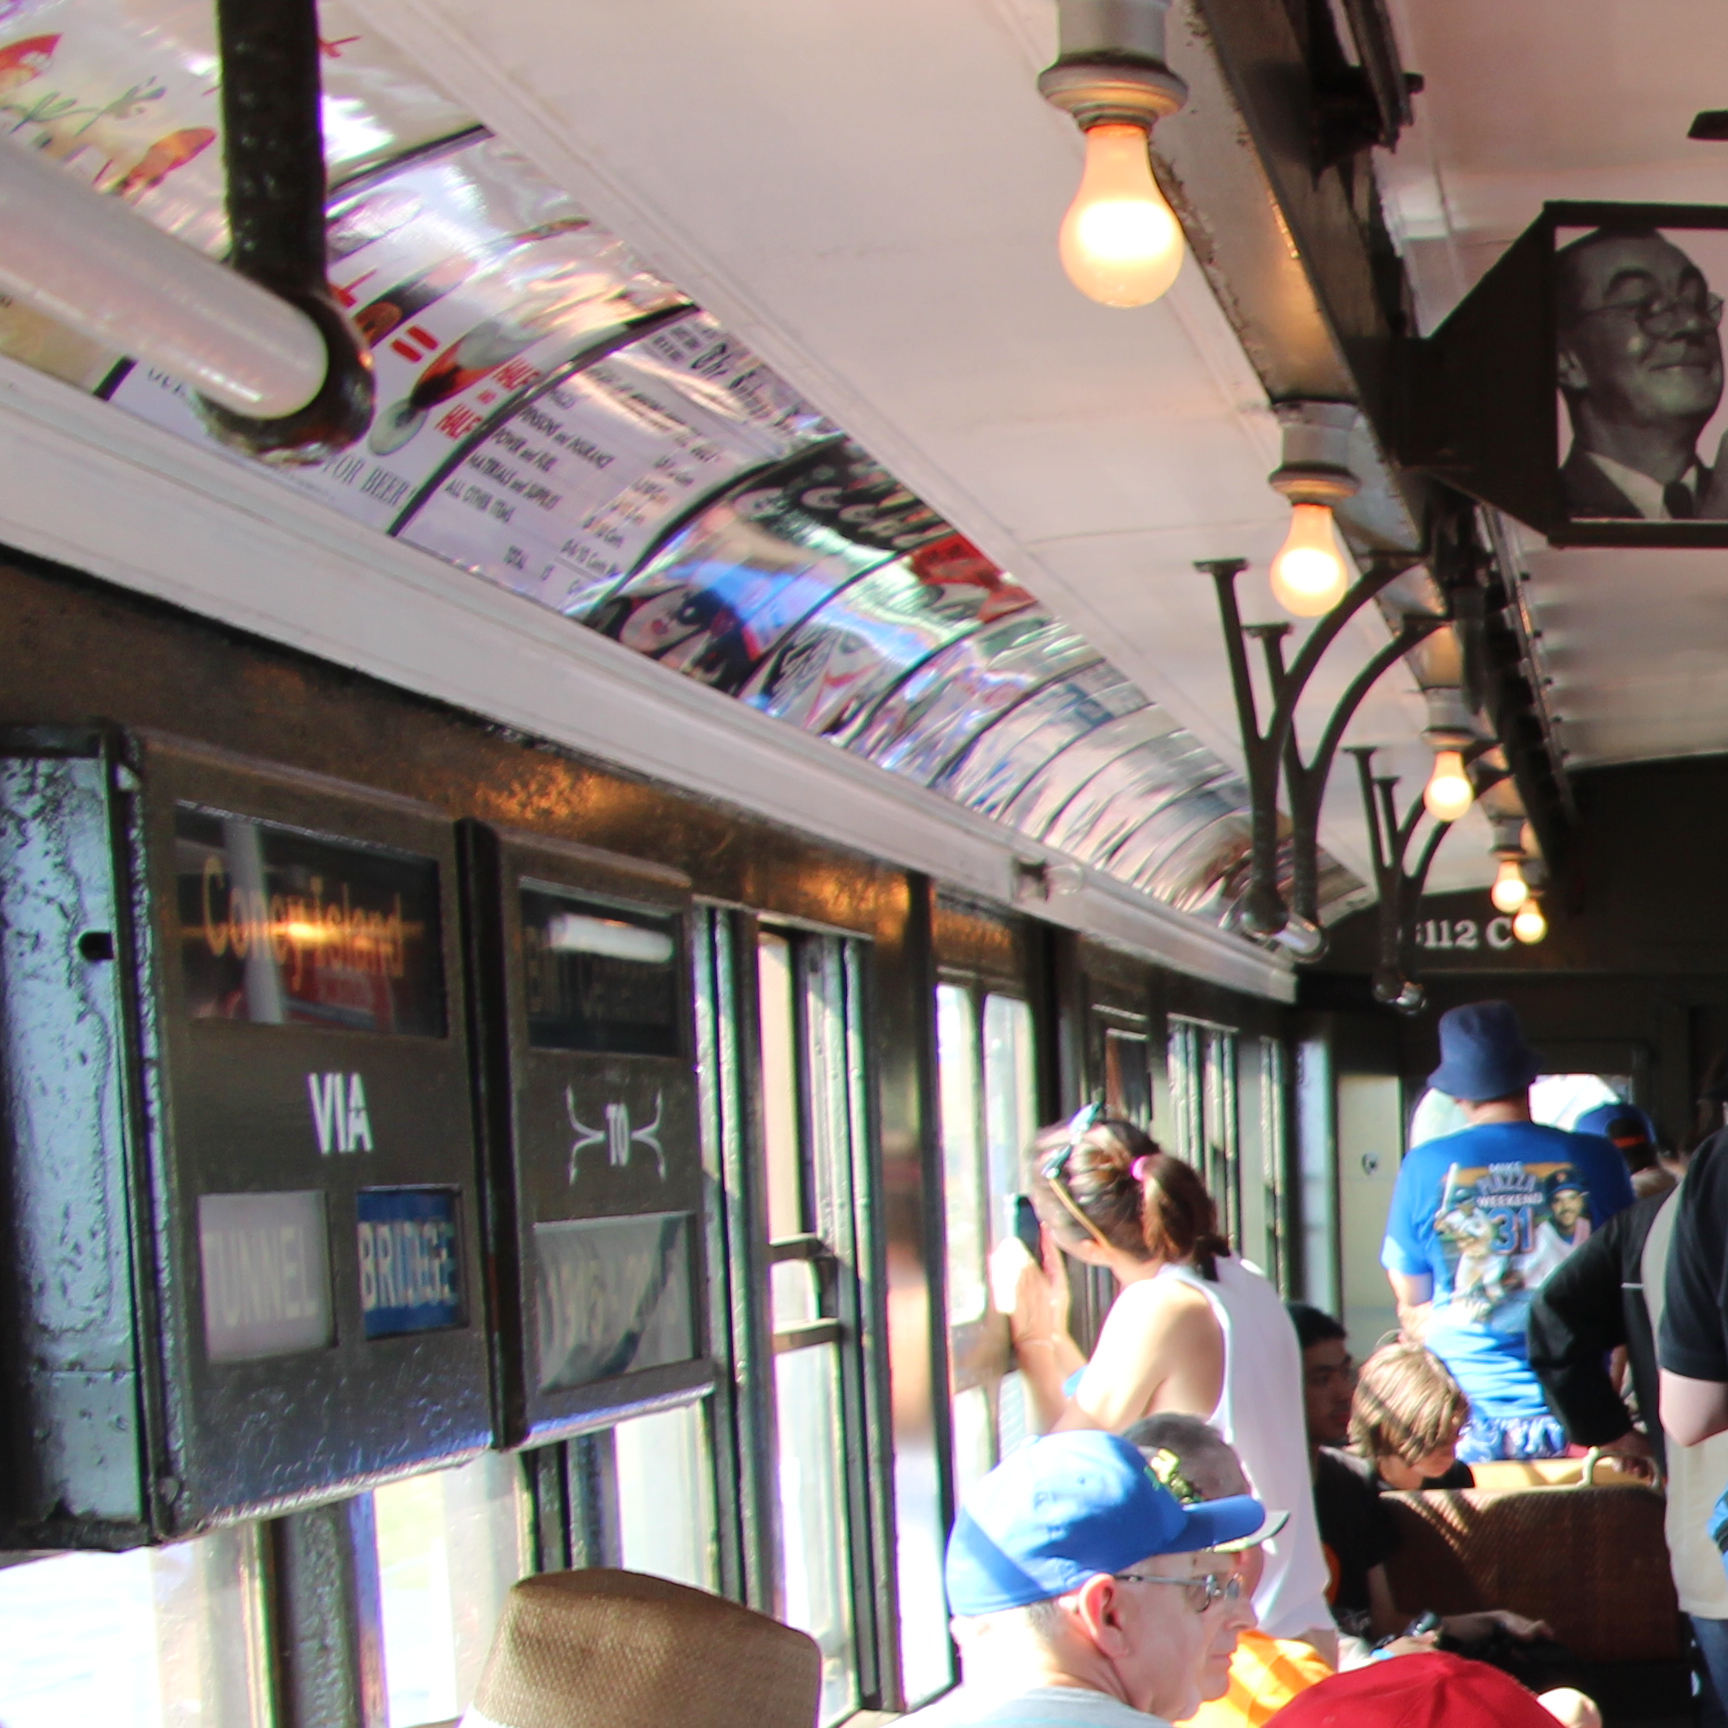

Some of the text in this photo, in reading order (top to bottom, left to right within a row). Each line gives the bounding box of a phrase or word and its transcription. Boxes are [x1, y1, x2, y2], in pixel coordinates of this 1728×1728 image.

[443, 478, 464, 499] ALL
[1485, 916, 1514, 949] C
[307, 1073, 373, 1154] VIA
[605, 1103, 630, 1167] TO
[1477, 1192, 1544, 1207] WEEKEND
[1489, 1206, 1535, 1255] 31
[358, 1222, 456, 1309] BRIDGE
